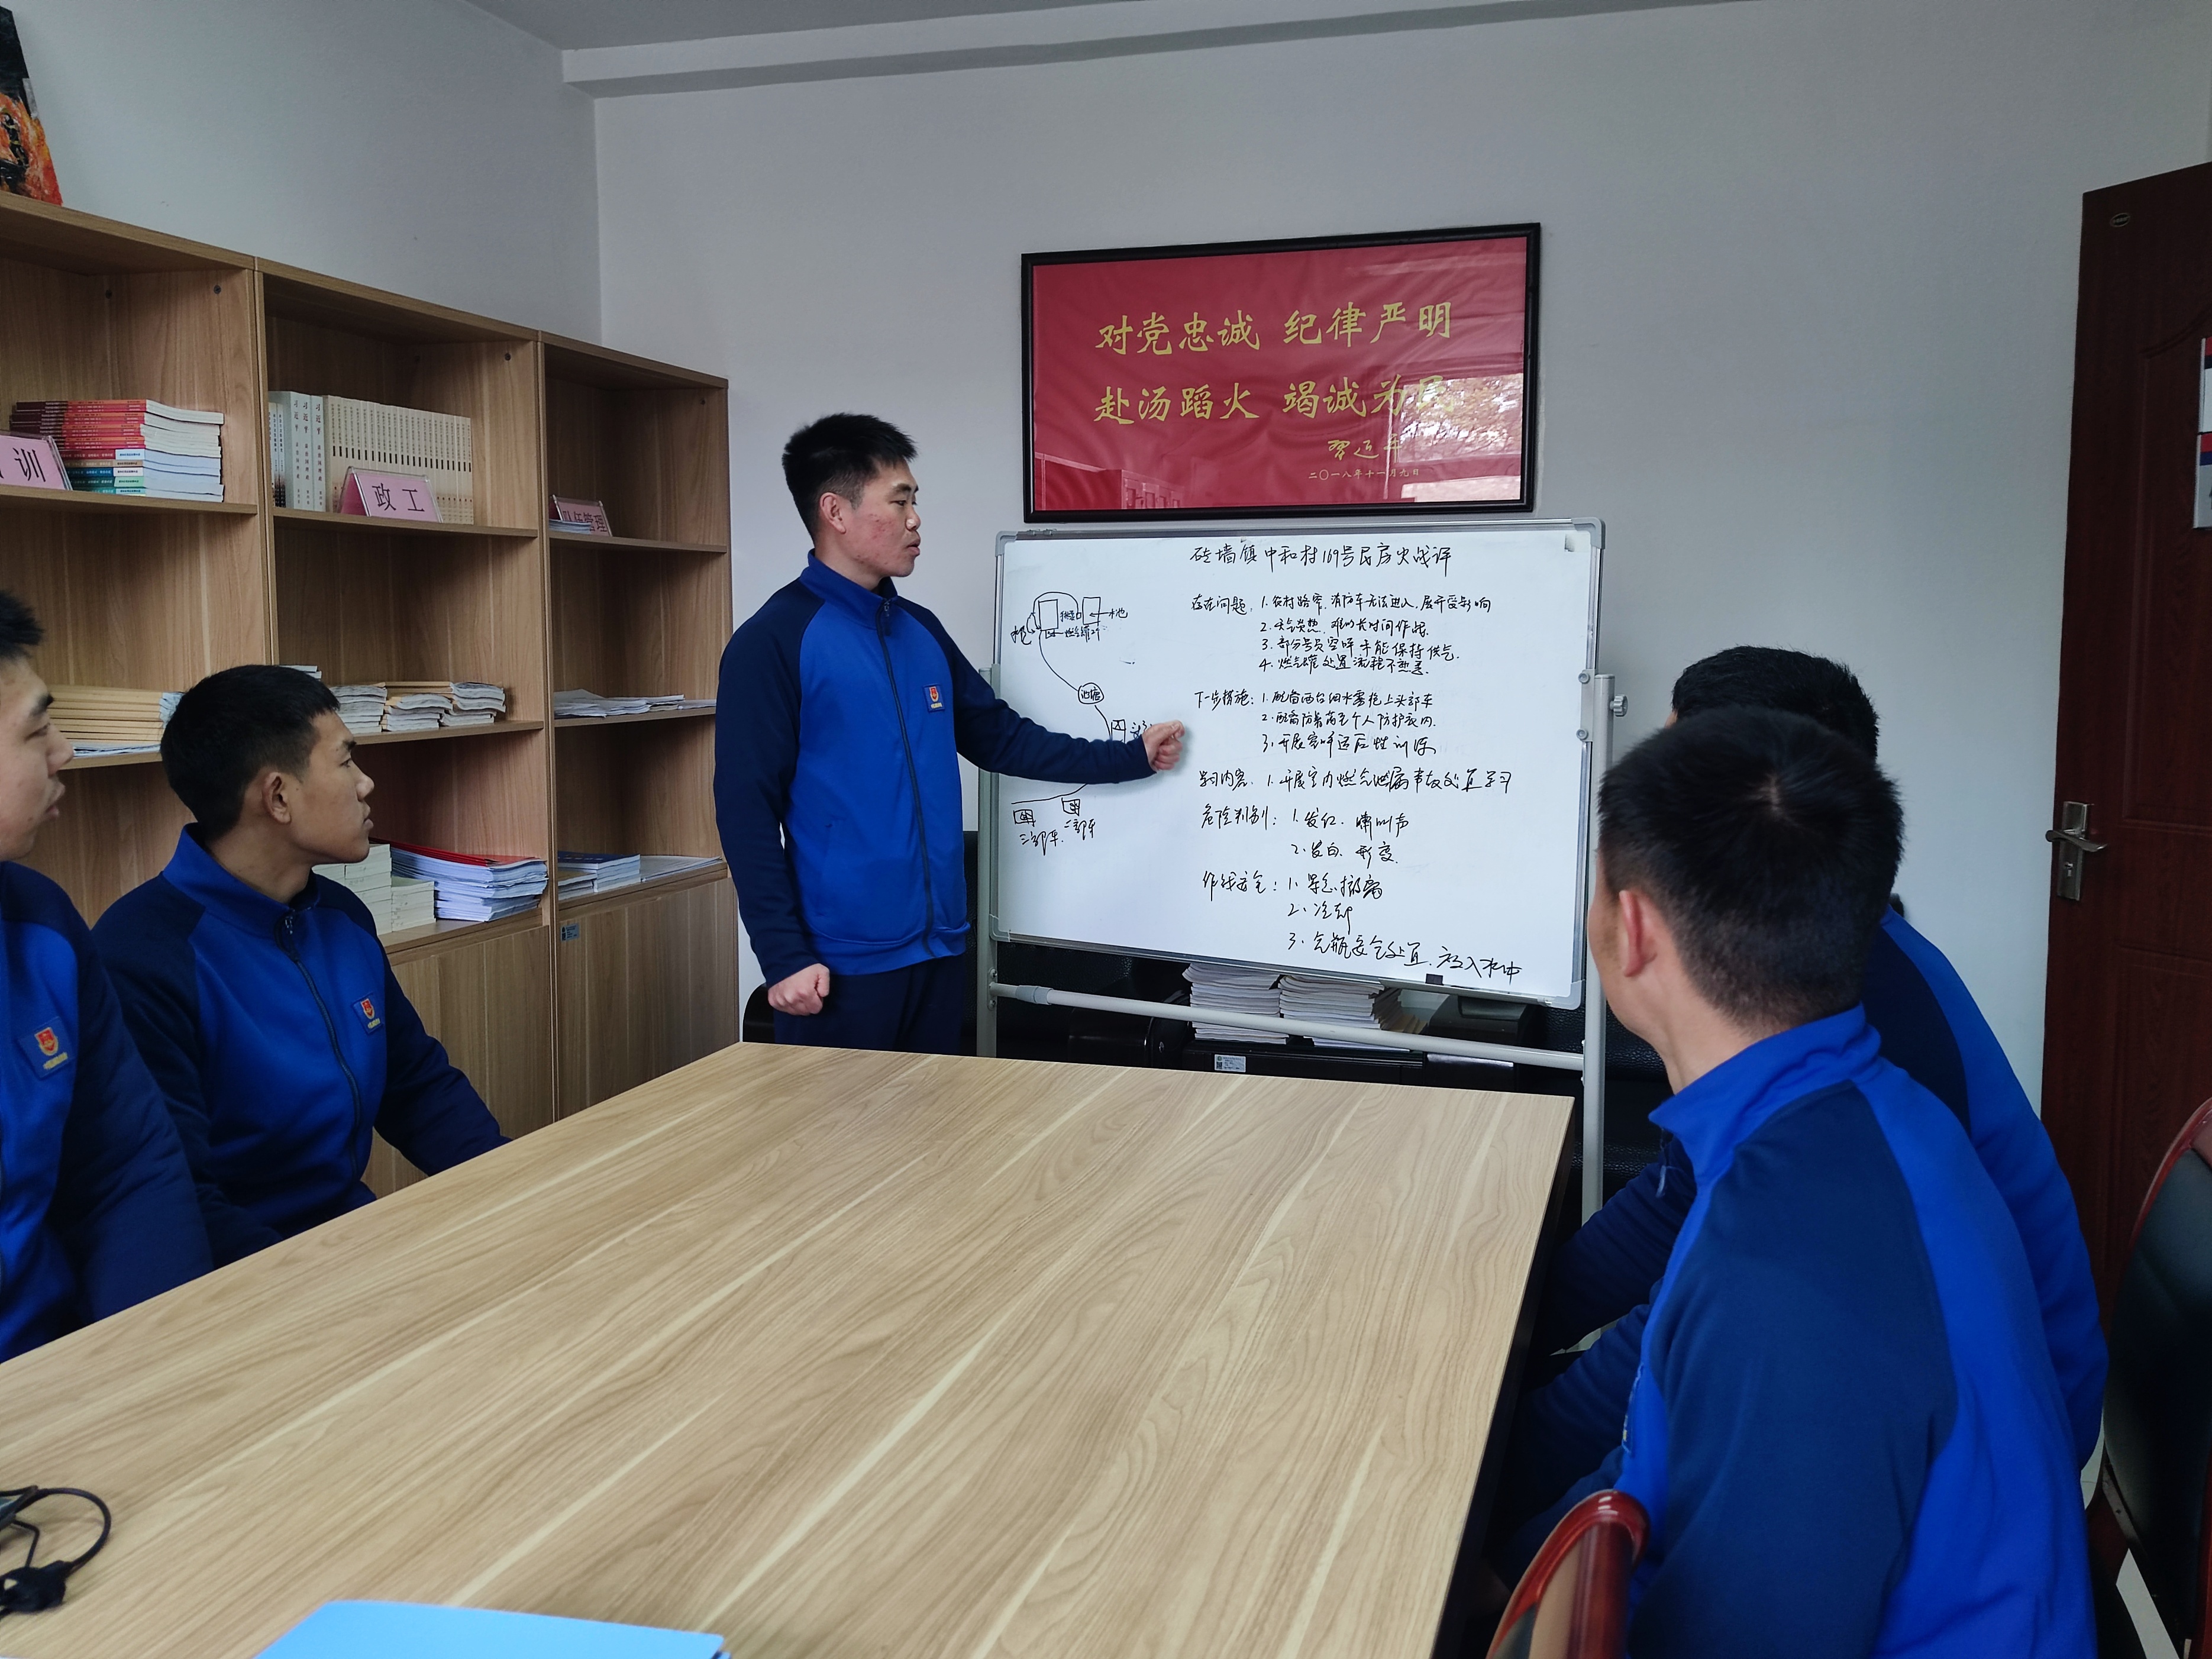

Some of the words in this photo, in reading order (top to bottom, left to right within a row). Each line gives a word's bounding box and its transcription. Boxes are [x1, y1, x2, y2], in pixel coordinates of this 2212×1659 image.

[1095, 309, 1260, 355] 对党忠诚
[1282, 301, 1452, 347] 纪律严明
[1093, 382, 1260, 425] 赴汤蹈火
[1282, 375, 1455, 420] 竭诚为民
[372, 483, 425, 512] 政工
